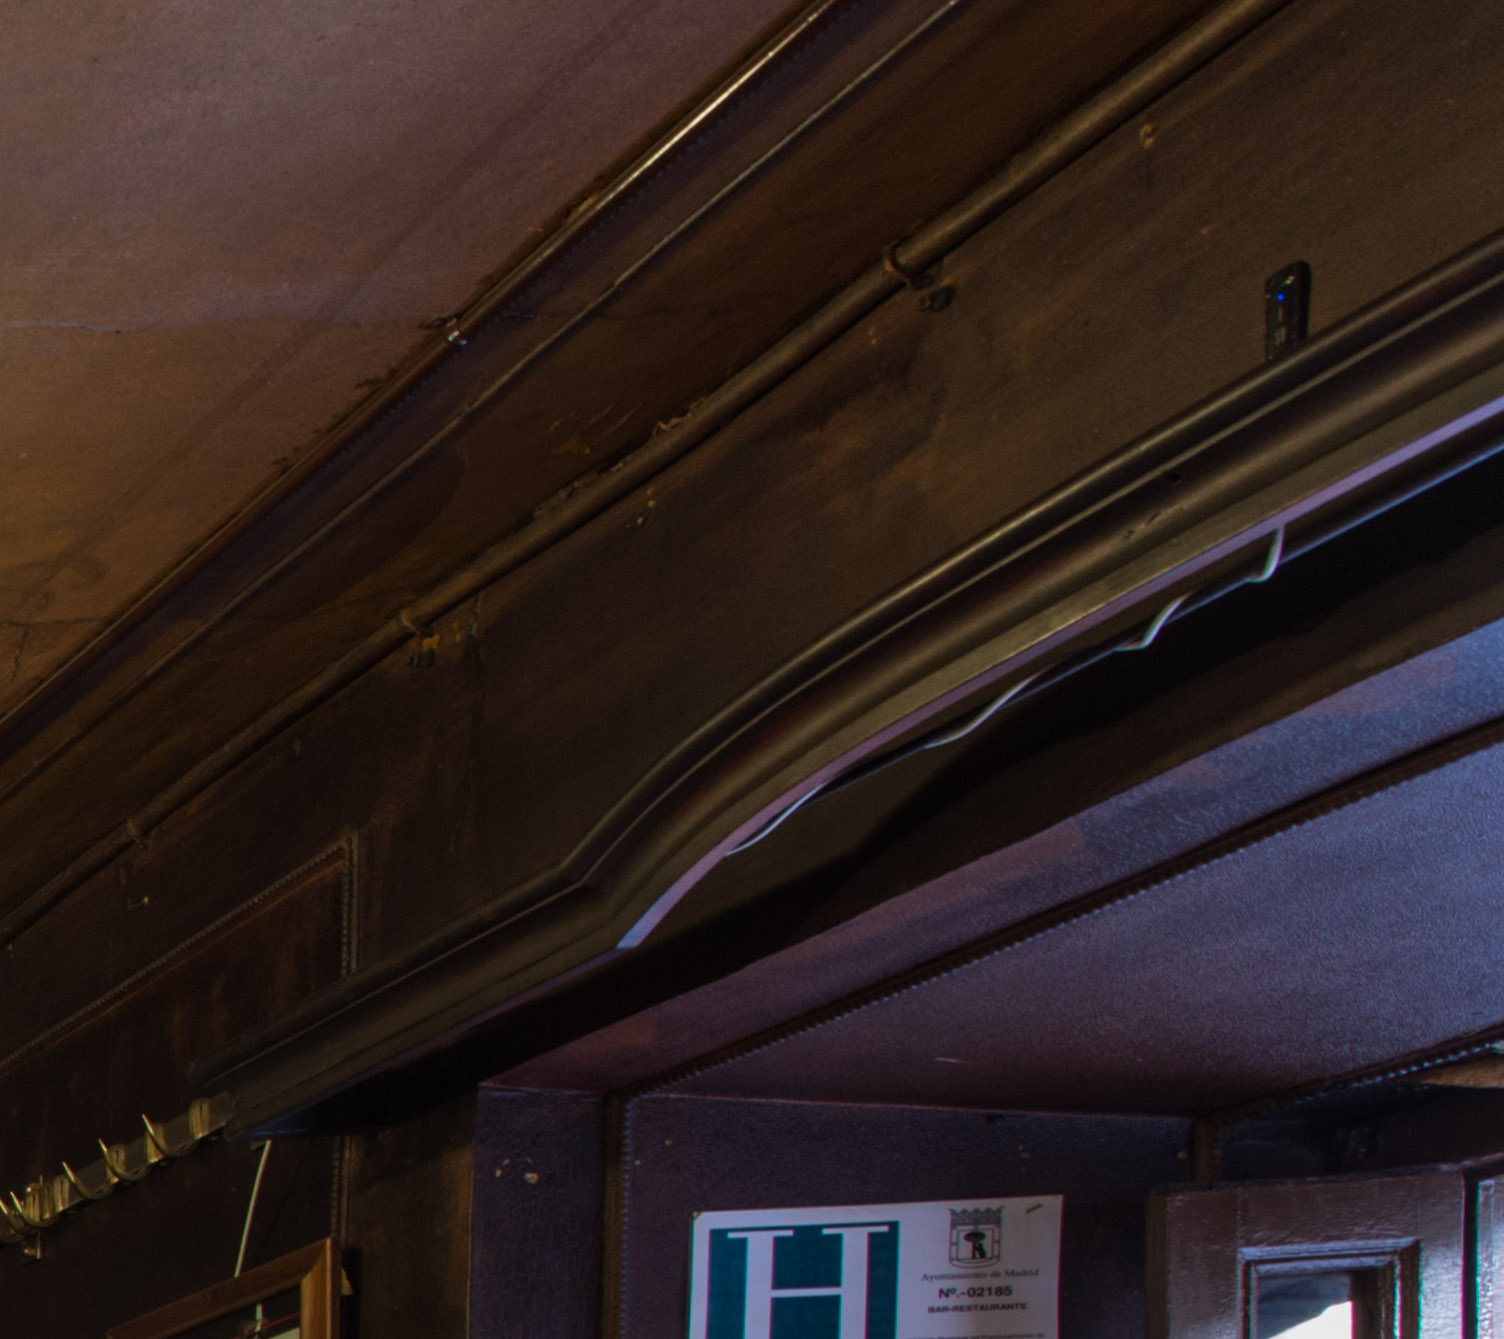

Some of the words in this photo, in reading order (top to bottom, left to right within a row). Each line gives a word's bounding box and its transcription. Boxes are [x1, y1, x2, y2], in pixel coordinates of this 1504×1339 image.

[990, 1270, 1002, 1279] de
[1004, 1268, 1040, 1278] Madrid
[928, 1302, 1028, 1314] BAR-RESTAURANTE
